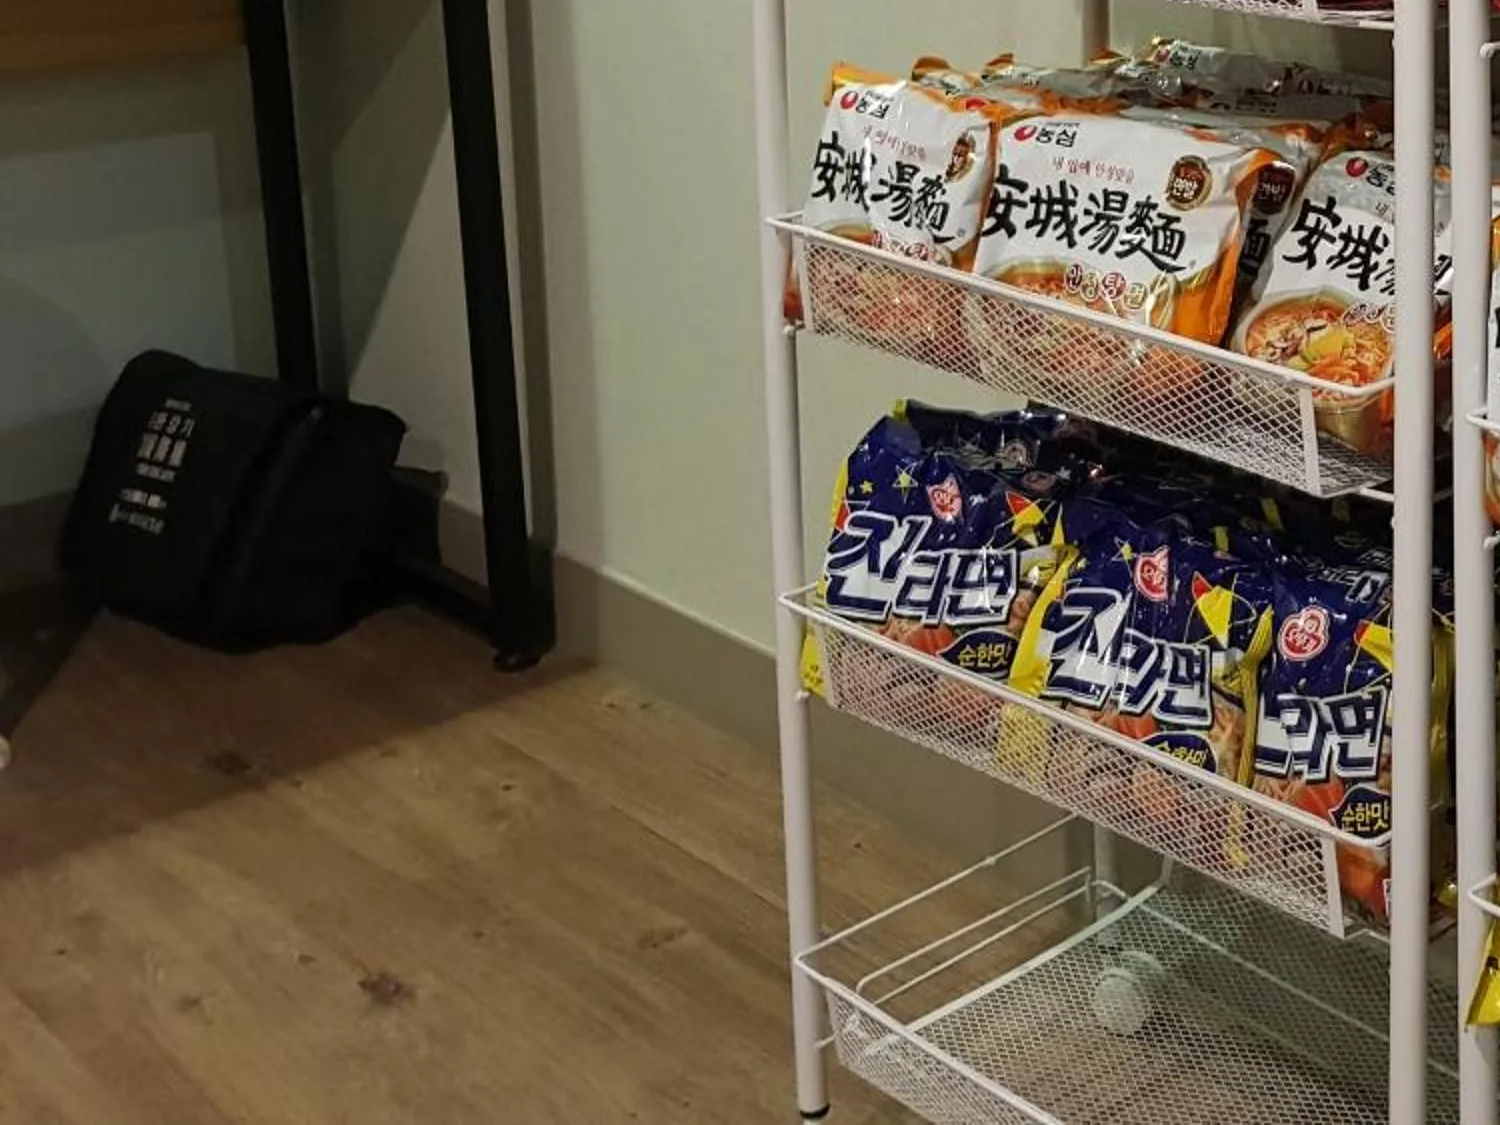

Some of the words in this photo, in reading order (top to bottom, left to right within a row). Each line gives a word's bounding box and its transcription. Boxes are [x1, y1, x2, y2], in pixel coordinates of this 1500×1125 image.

[1036, 126, 1078, 148] 농심
[823, 510, 1020, 627] 진라면
[957, 643, 1010, 668] 순한맛
[1341, 801, 1391, 832] 순한맛
